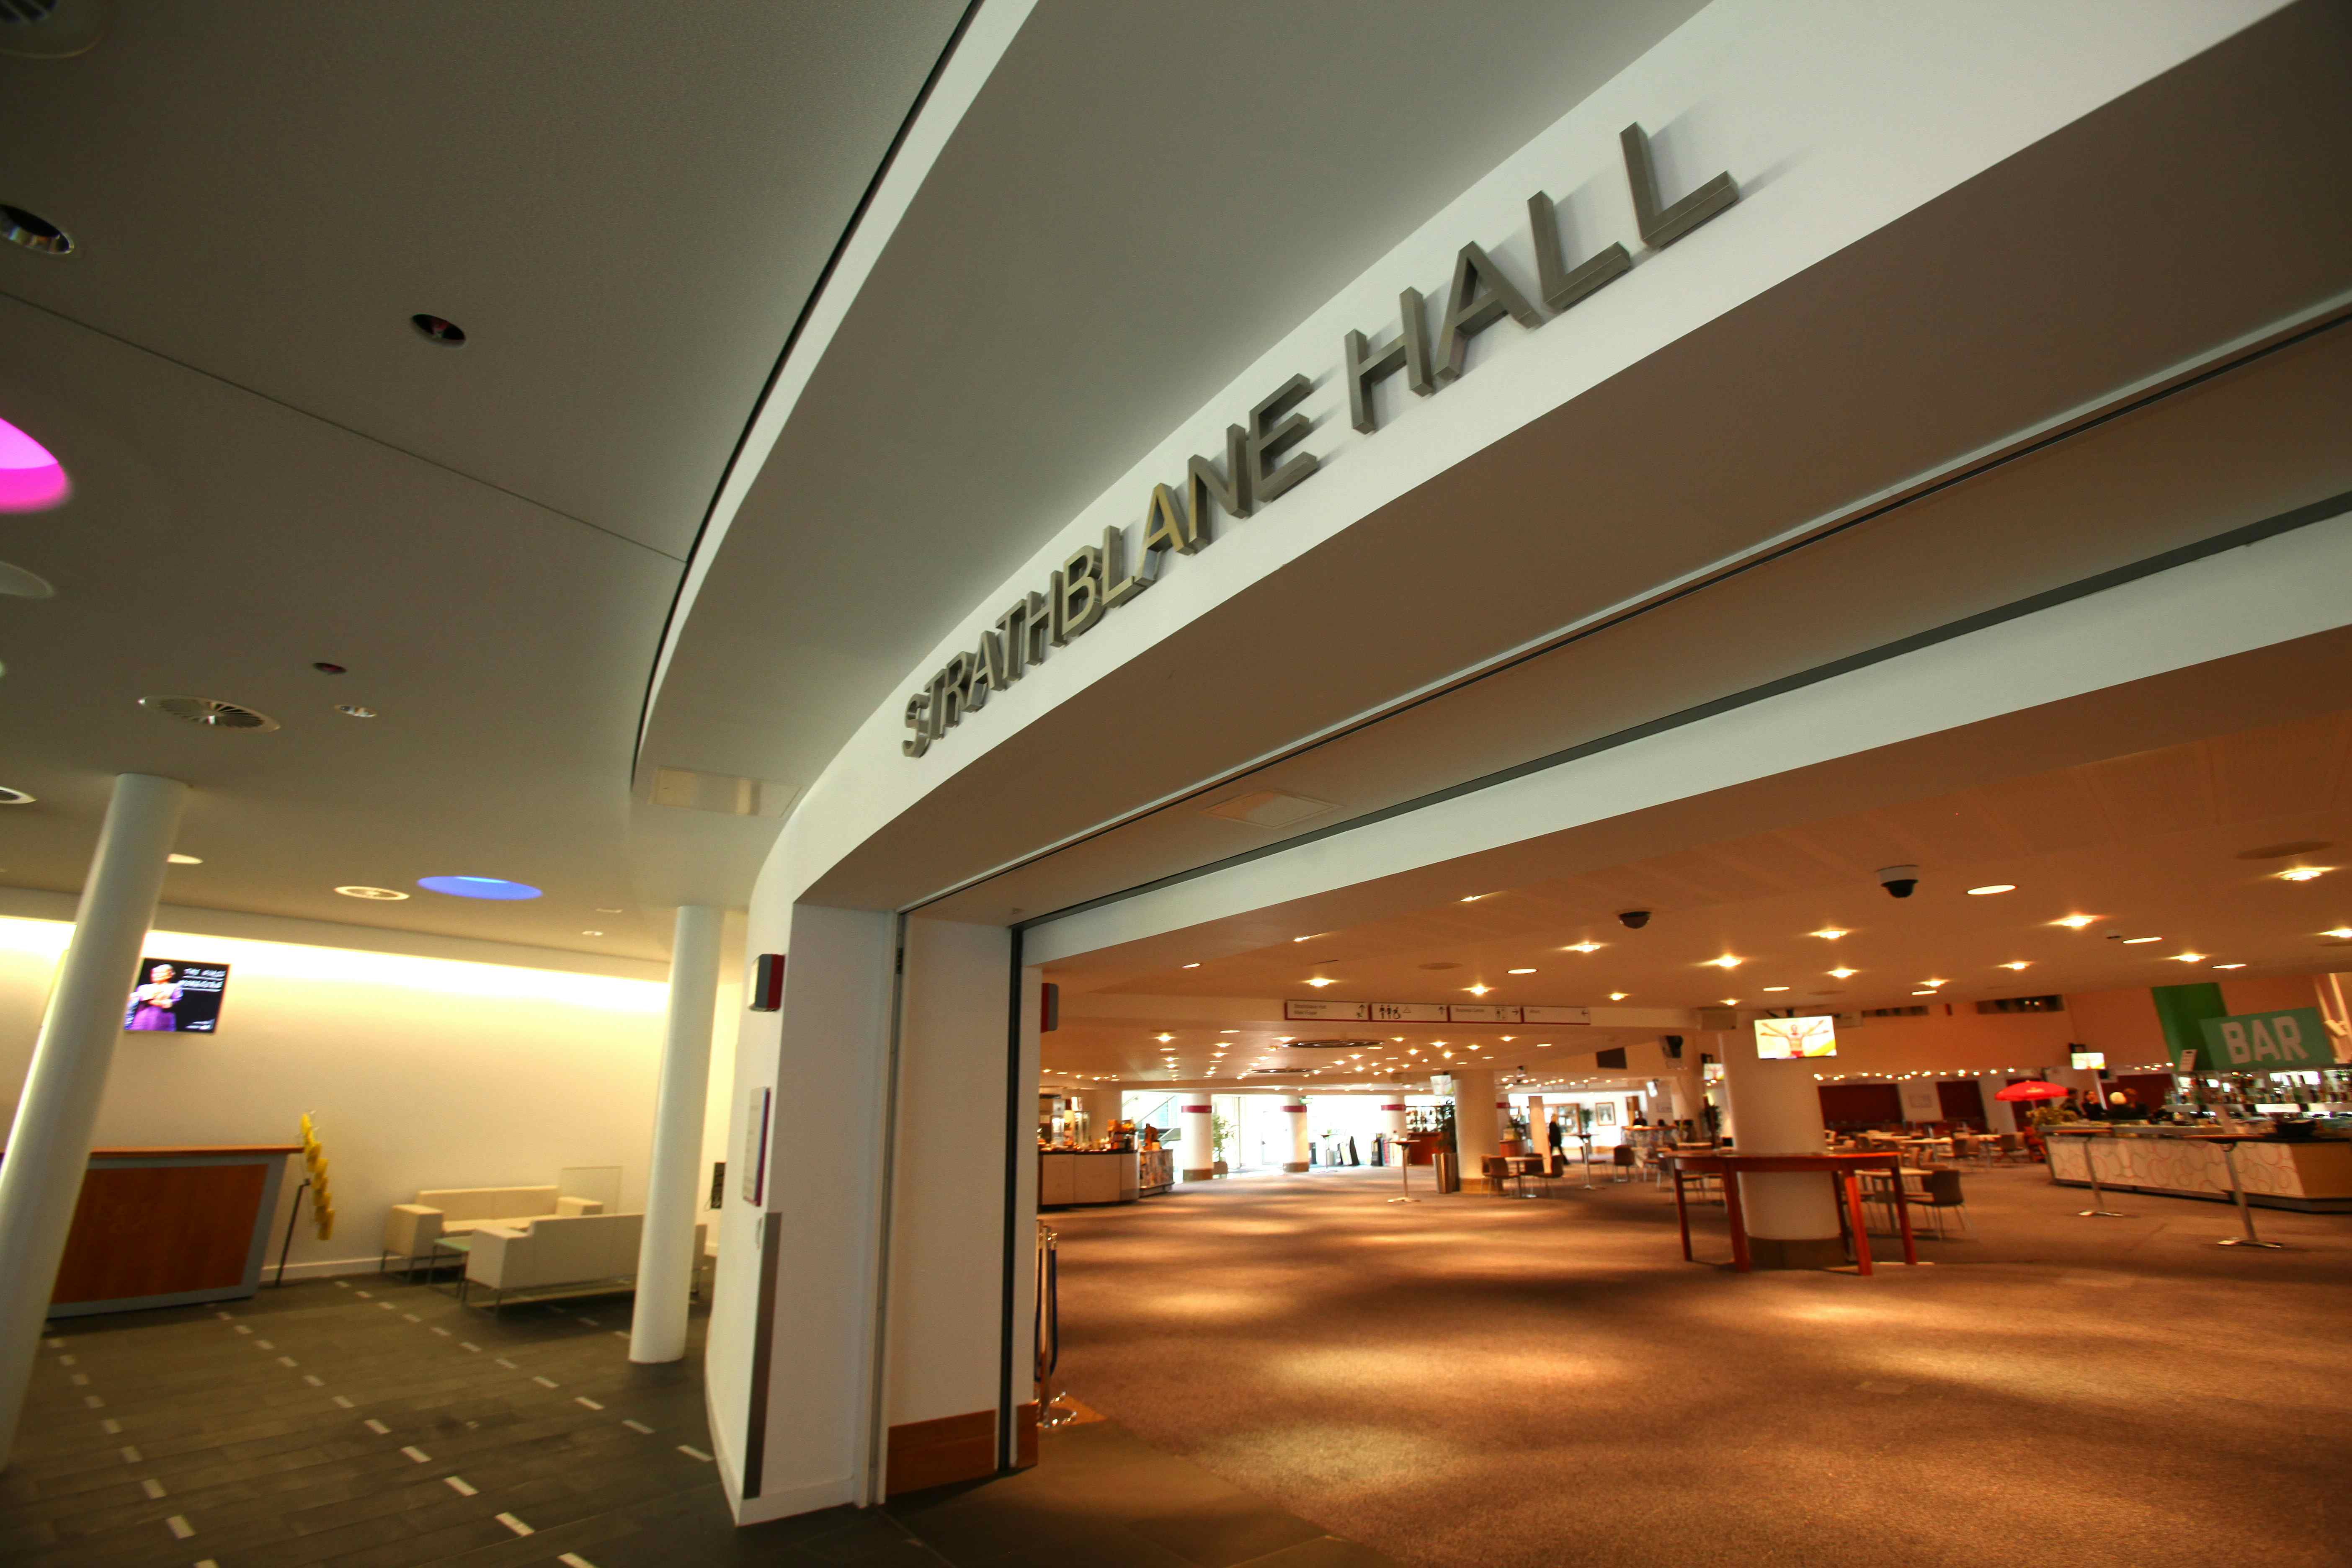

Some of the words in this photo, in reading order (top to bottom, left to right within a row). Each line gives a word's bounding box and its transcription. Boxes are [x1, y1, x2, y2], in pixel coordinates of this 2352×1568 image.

[902, 372, 1318, 758] STRATHBLANE
[1344, 121, 1739, 435] HALL
[2220, 1016, 2310, 1064] BAR
